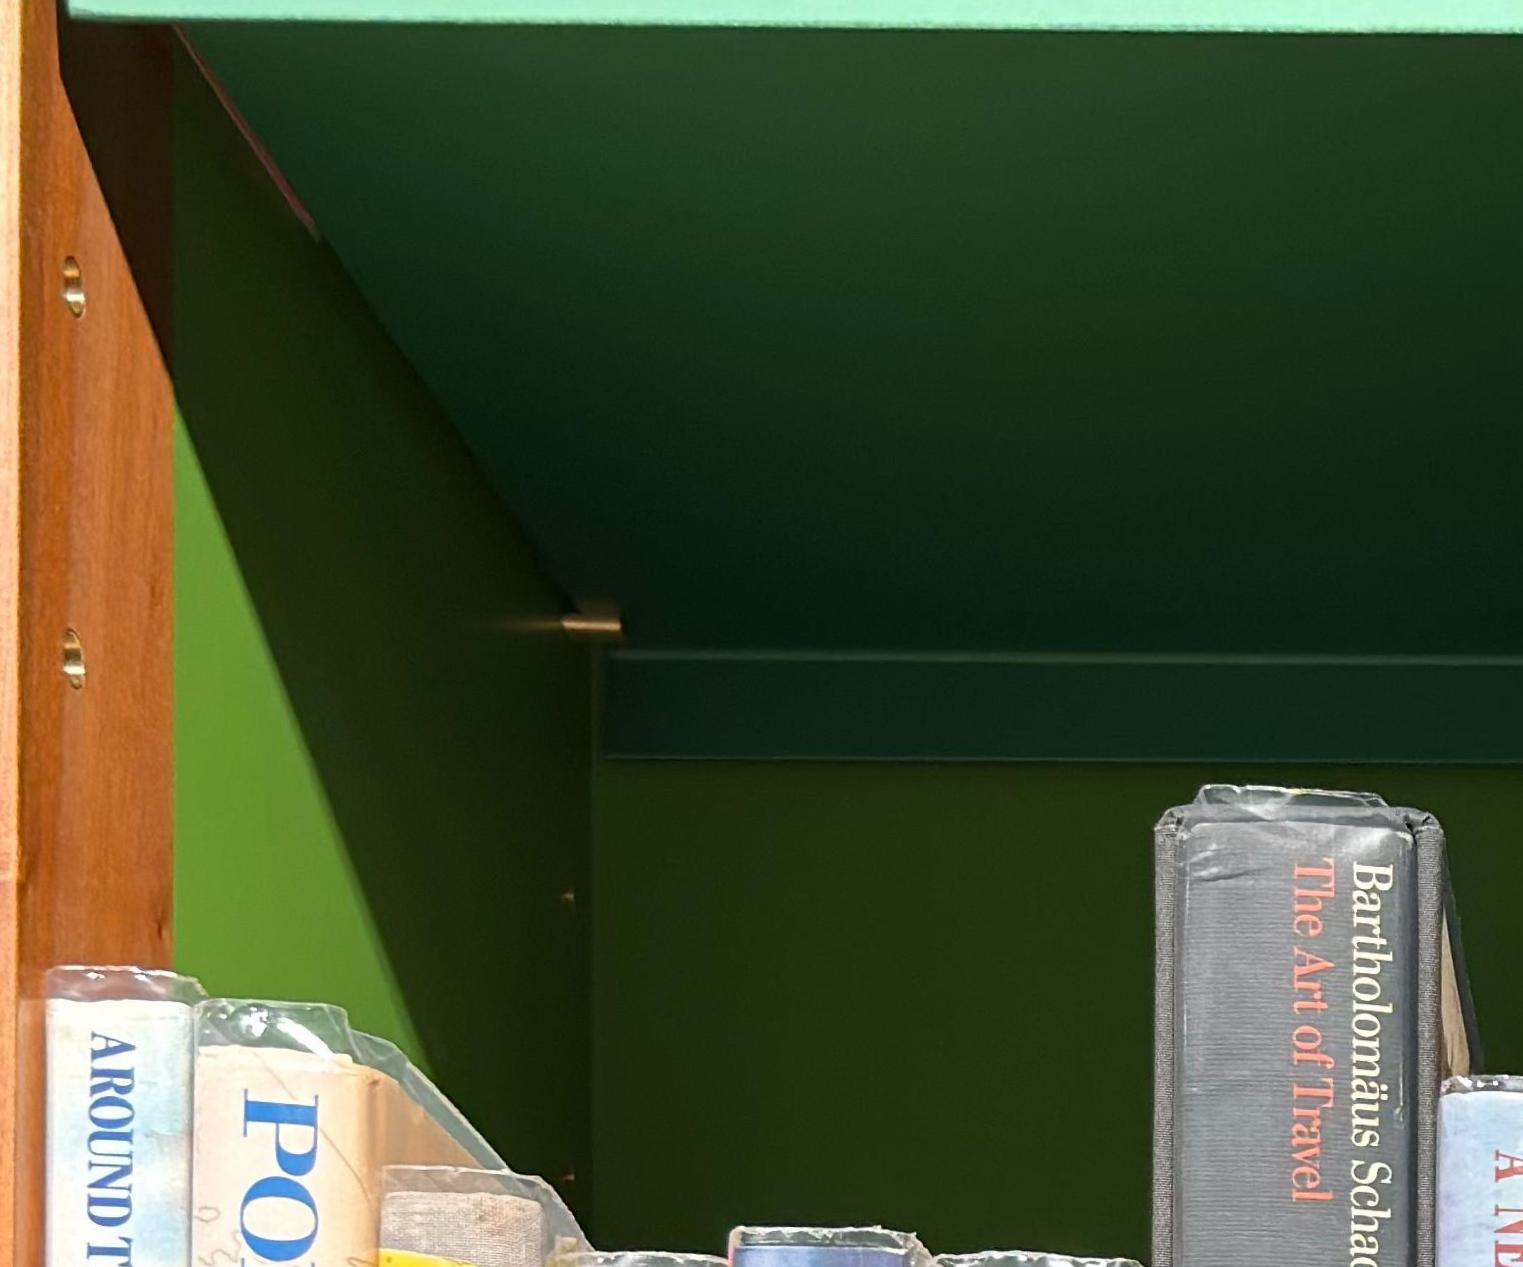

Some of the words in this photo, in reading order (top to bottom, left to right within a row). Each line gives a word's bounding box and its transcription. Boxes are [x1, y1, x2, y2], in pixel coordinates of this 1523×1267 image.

[1293, 857, 1336, 938] The
[1292, 947, 1336, 1016] Art
[1350, 861, 1394, 1148] Bartholomäus
[1290, 1025, 1336, 1066] of
[82, 1031, 136, 1227] AROUND
[1290, 1078, 1335, 1203] Travel
